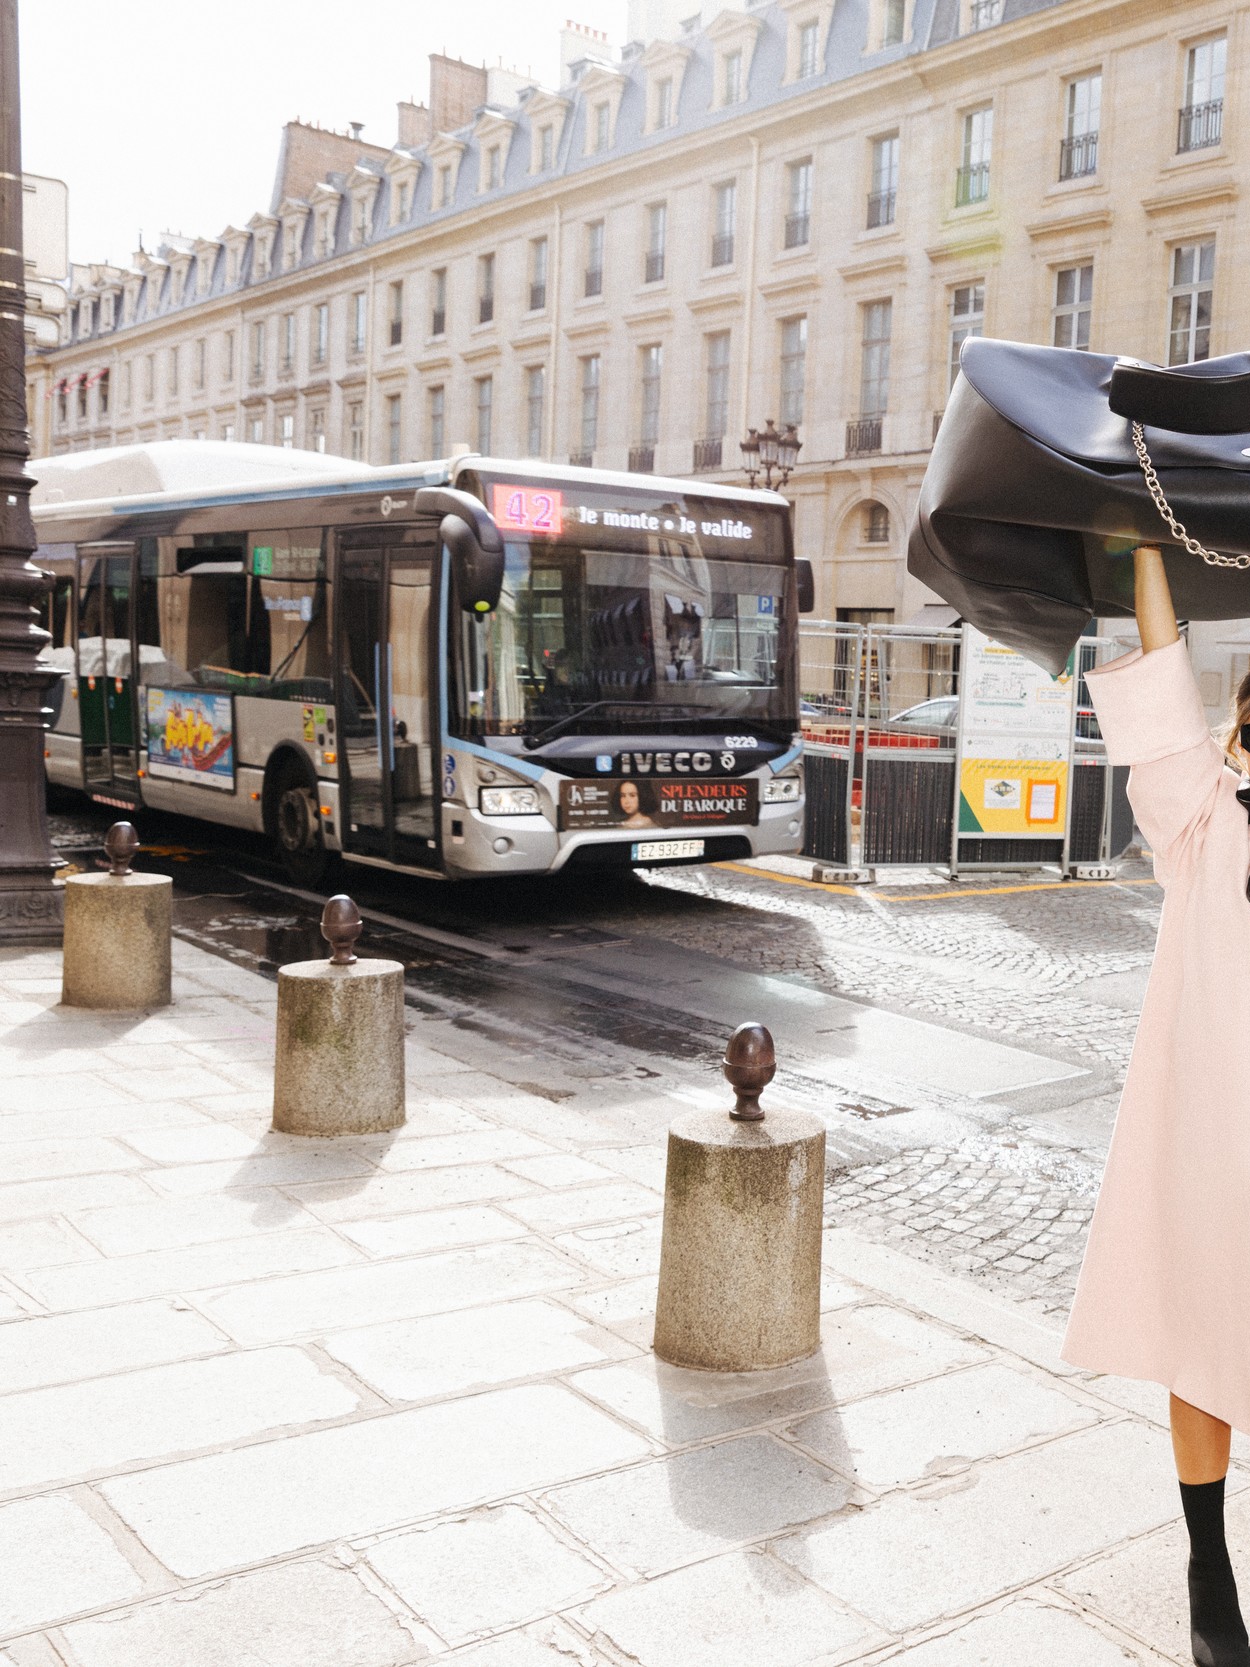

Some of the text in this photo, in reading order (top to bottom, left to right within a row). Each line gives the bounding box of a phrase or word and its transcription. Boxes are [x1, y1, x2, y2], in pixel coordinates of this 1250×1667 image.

[504, 490, 555, 530] 42
[579, 505, 752, 540] Je monte Je valide
[724, 735, 758, 749] 6229
[620, 751, 713, 774] IVECO
[660, 783, 748, 799] SPLENDEURS
[660, 797, 748, 814] DU BAROQUE
